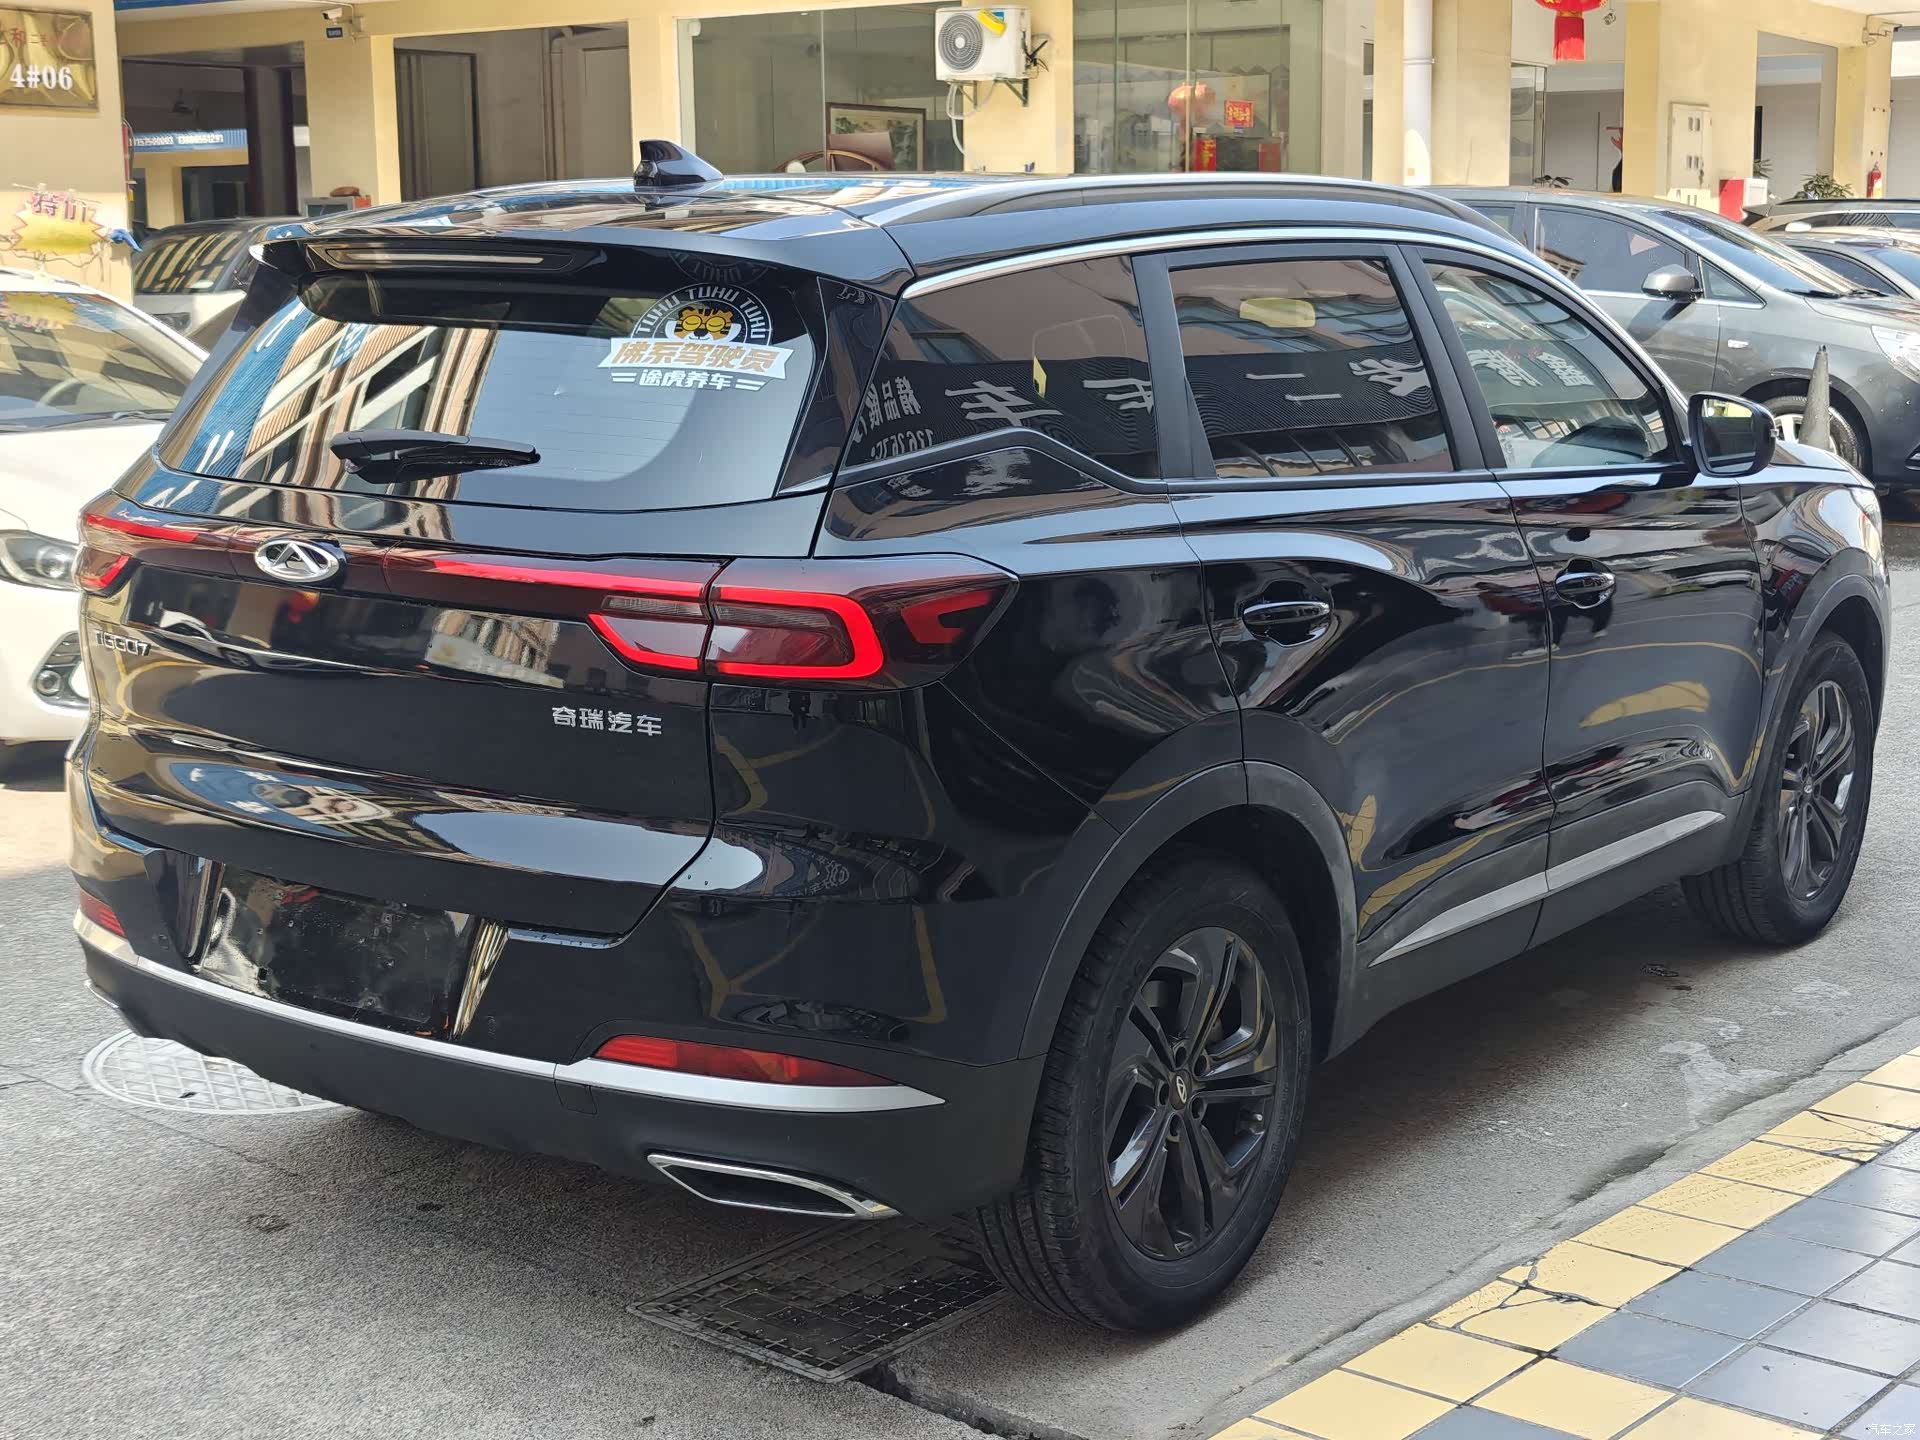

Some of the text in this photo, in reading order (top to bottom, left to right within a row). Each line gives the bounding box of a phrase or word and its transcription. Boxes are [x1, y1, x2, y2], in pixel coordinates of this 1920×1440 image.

[10, 63, 73, 90] 4#06
[636, 285, 766, 339] TUHU TUHU TUHU
[611, 341, 781, 372] 佛系驾驶员
[638, 369, 734, 390] 途虎养车
[551, 705, 662, 736] 奇瑞汽车
